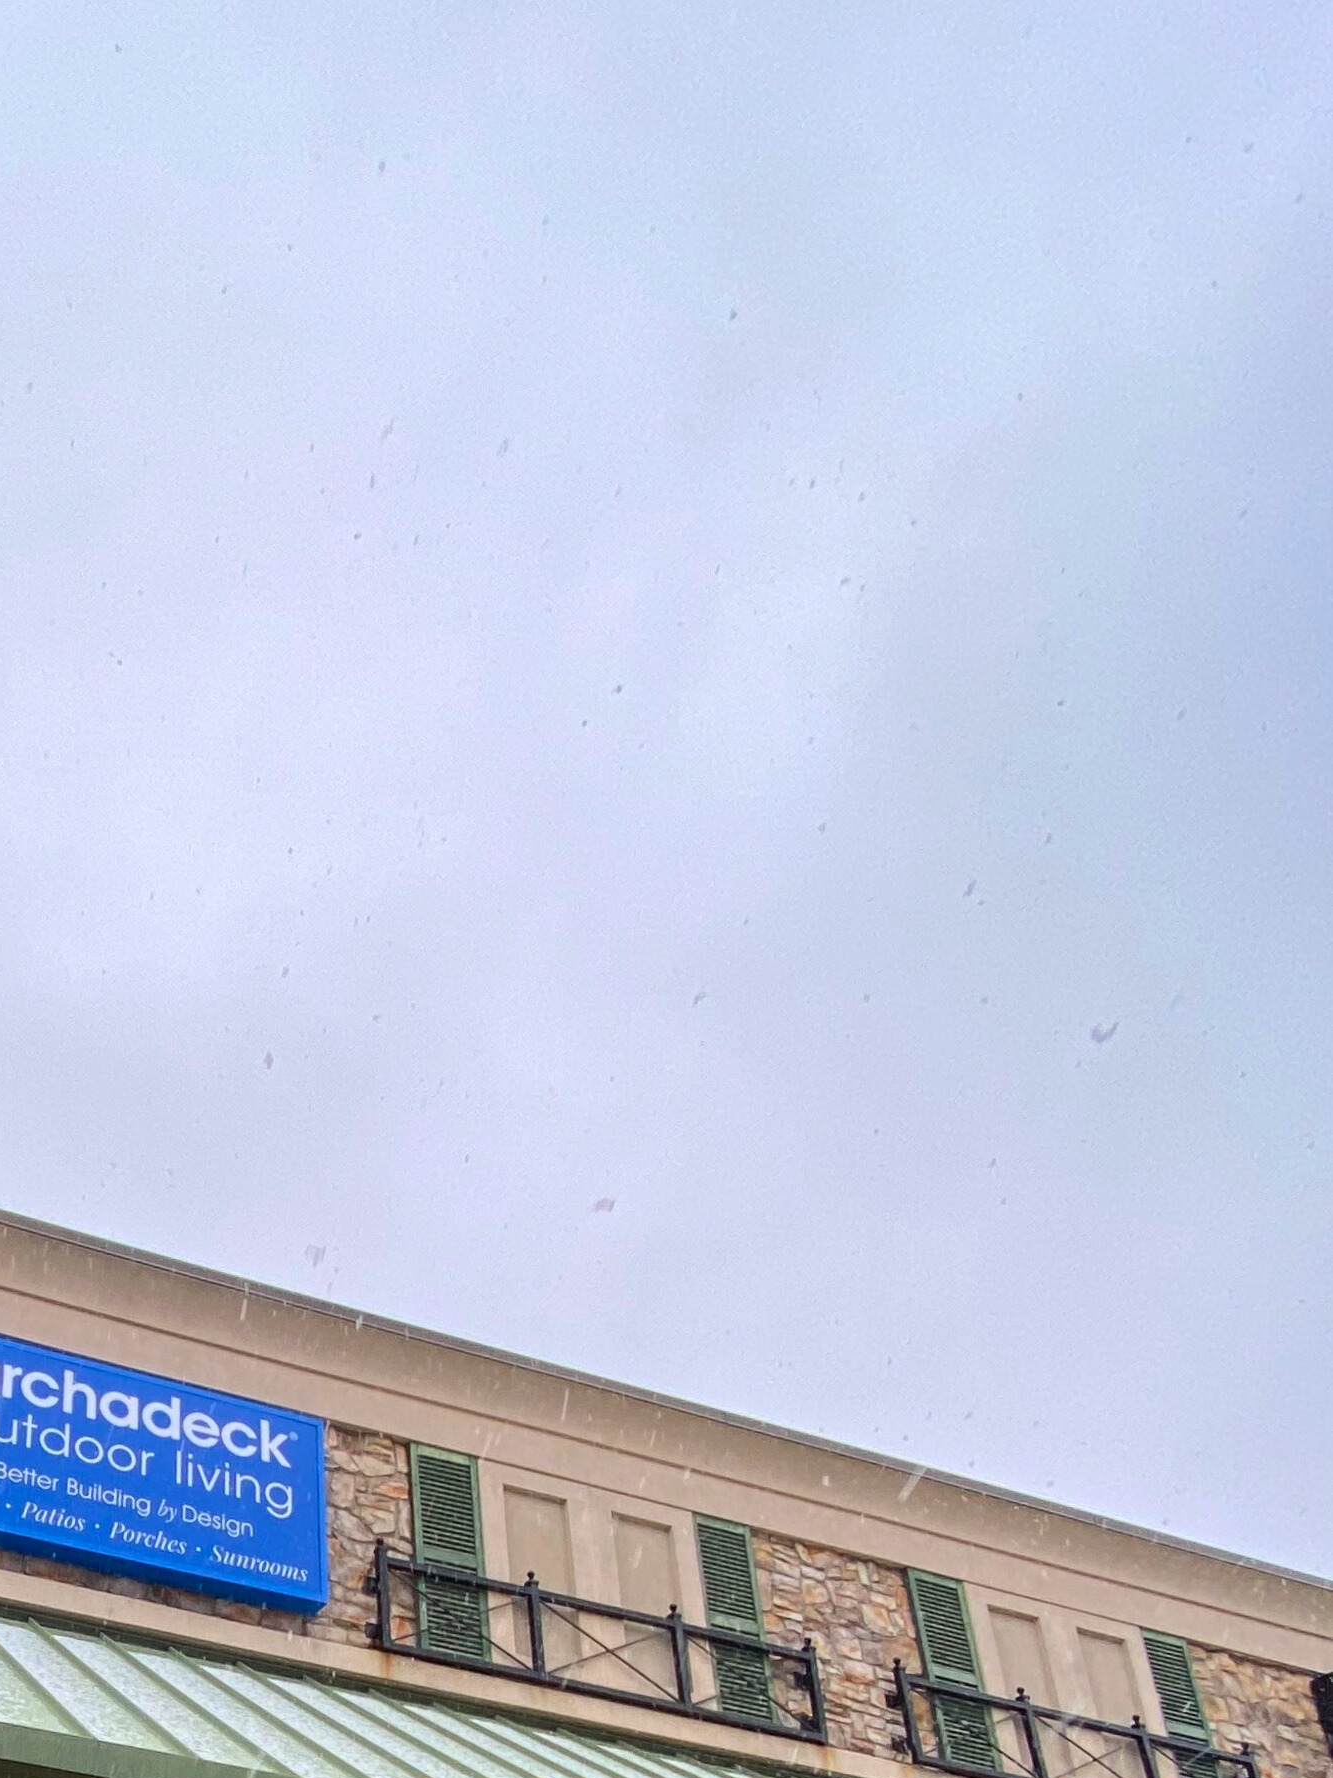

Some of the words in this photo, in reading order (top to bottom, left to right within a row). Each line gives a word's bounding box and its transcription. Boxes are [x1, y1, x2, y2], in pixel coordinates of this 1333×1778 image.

[66, 1477, 151, 1517] Building
[157, 1499, 178, 1523] by
[181, 1504, 254, 1538] Design
[175, 1450, 293, 1519] living
[20, 1501, 86, 1532] Patios
[109, 1521, 188, 1556] Porches
[208, 1543, 309, 1583] Sunrooms
